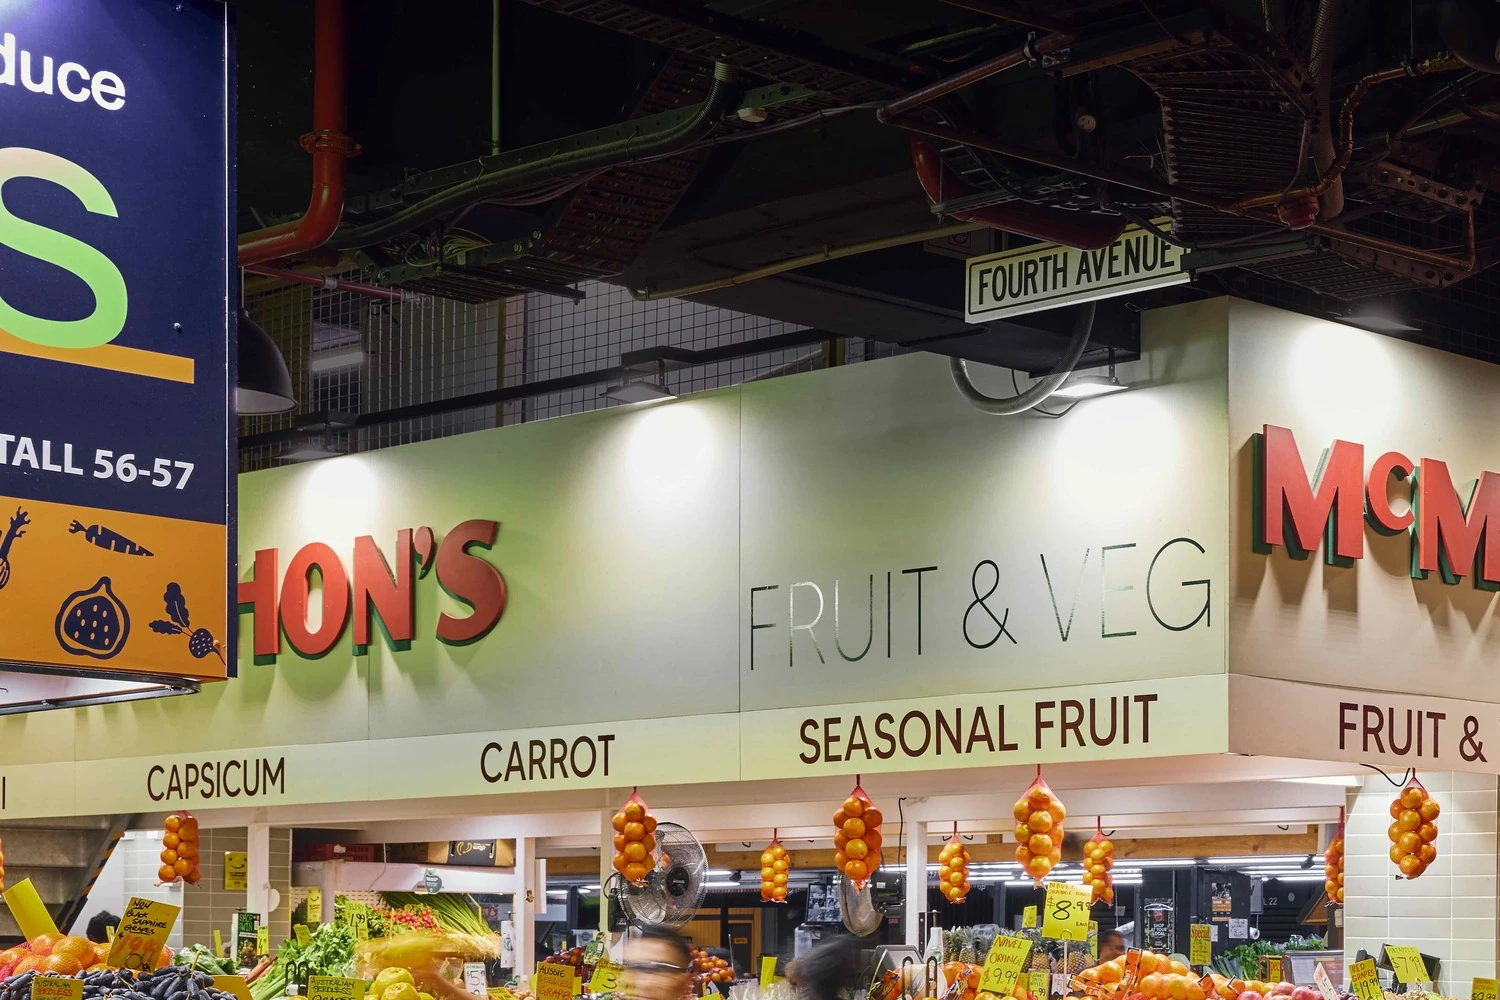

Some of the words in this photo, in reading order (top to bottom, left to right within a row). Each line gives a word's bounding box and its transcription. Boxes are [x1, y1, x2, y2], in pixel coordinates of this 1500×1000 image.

[977, 254, 1067, 306] FOURTH
[1075, 236, 1176, 286] AVENUE
[93, 449, 194, 490] 56-57
[749, 565, 938, 671] FRUIT
[962, 559, 1018, 650] &
[1040, 537, 1212, 644] VEG
[798, 704, 1020, 765] SEASONAL
[1035, 693, 1159, 750] FRUIT
[1339, 701, 1447, 758] FRUIT
[1459, 714, 1488, 763] &
[480, 734, 616, 785] CARROT
[147, 756, 286, 802] CAPSICUM
[126, 910, 148, 919] BLACK
[124, 925, 155, 935] GRAPES
[132, 918, 167, 929] SAPPHIRE
[994, 937, 1024, 950] NAVEL
[989, 952, 1024, 966] ORANGE
[539, 965, 566, 978] AUSSIE
[1352, 963, 1366, 974] RED
[1352, 969, 1376, 982] GRAPES
[35, 979, 72, 989] AUSTRALIAN
[310, 977, 356, 988] AUSTRALIAN
[36, 988, 73, 997] SEEDLESS
